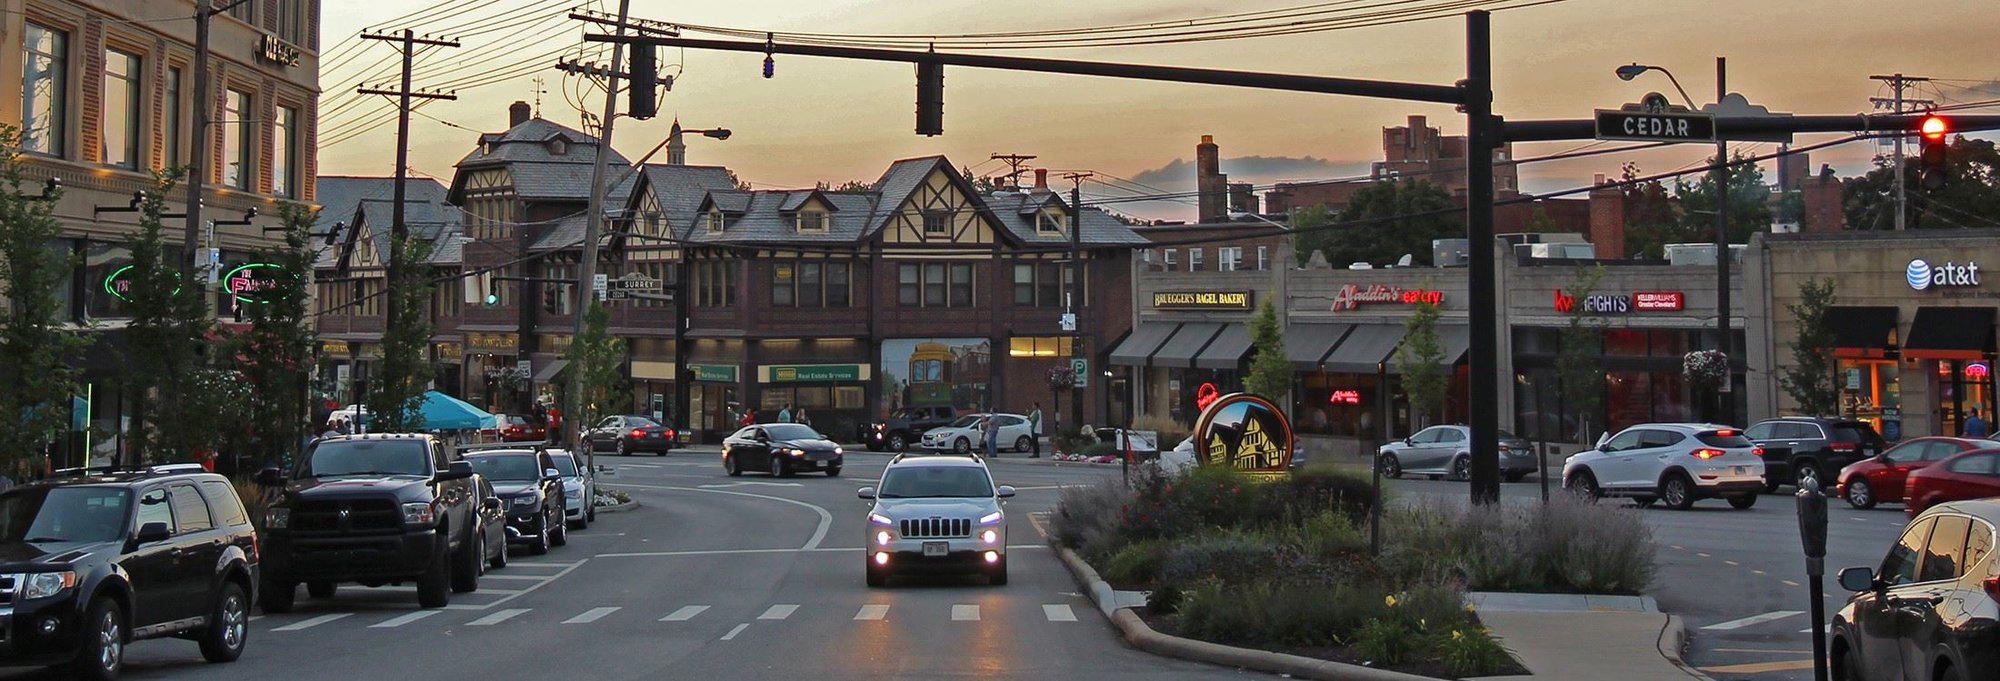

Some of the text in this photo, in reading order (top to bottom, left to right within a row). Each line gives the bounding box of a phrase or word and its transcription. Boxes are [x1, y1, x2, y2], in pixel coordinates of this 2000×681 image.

[1623, 117, 1688, 136] CEDAR
[1933, 262, 1979, 286] at&t
[624, 281, 654, 289] SURREY
[1154, 293, 1247, 307] BRUEGGER'S BAGEL BAKERY
[1331, 284, 1401, 312] Aladdin's
[1966, 367, 1987, 377] OPEN
